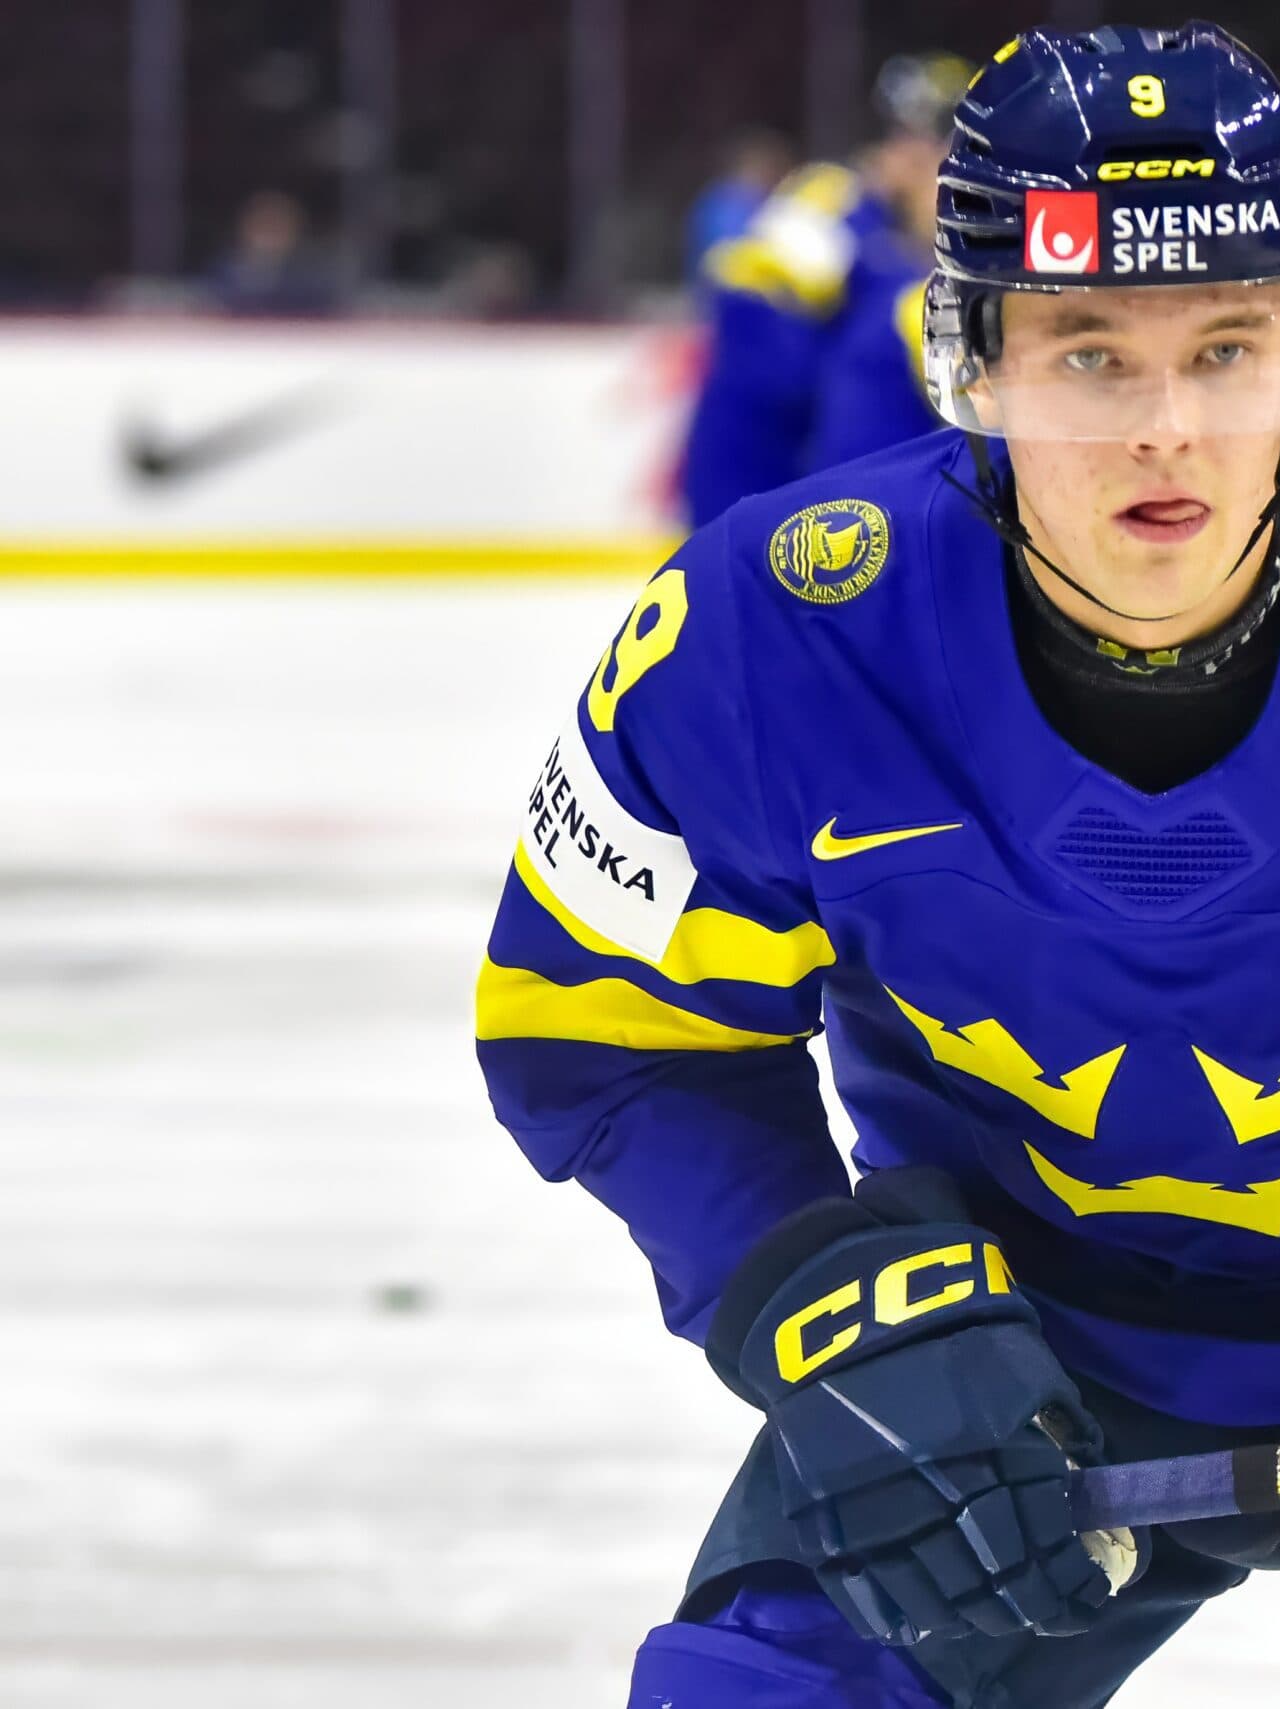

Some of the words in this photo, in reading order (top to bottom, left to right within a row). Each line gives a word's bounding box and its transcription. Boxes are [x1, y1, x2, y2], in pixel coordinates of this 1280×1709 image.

[1127, 74, 1165, 118] 9
[1098, 157, 1215, 182] CCM
[1112, 200, 1280, 240] SVENSKA
[1113, 241, 1208, 274] SPEL
[587, 568, 689, 732] 9
[529, 772, 560, 869] PEL
[545, 736, 654, 901] VENSKA
